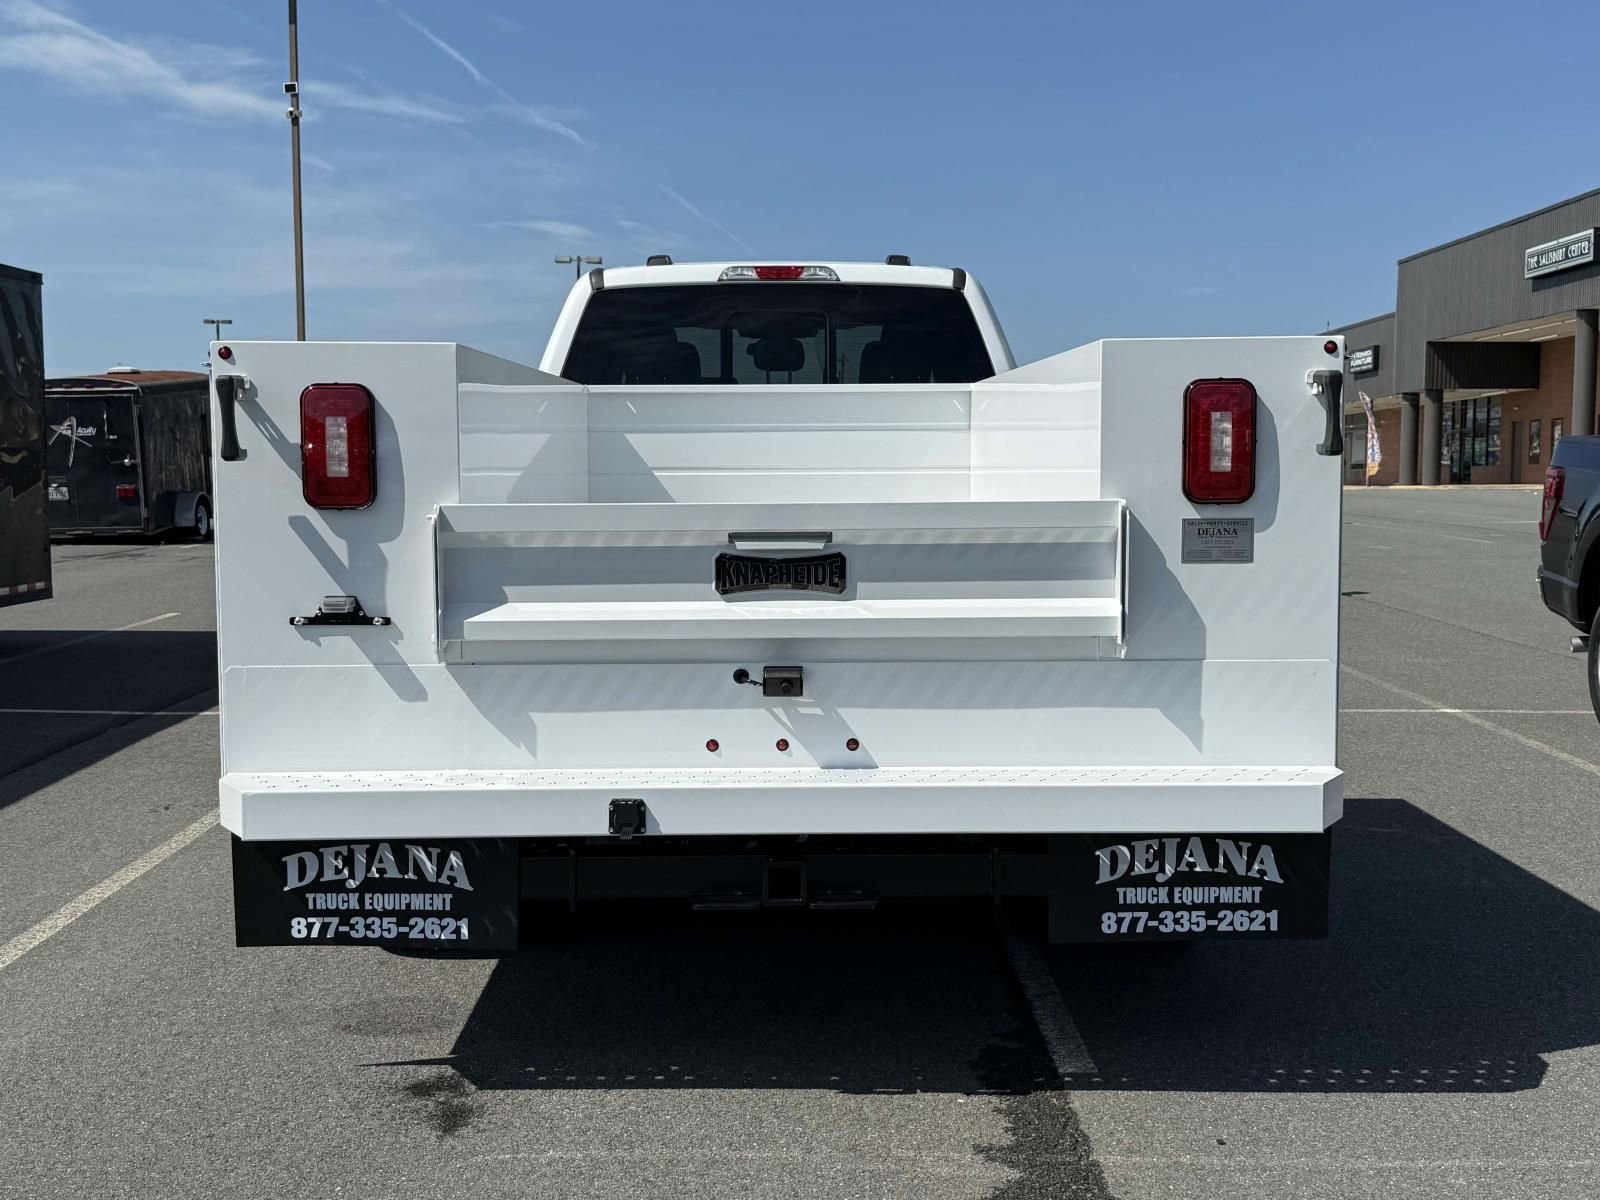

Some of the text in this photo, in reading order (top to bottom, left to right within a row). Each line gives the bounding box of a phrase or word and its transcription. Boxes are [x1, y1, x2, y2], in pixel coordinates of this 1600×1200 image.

[1527, 256, 1538, 270] THE
[1567, 240, 1589, 258] CENTER
[1197, 527, 1239, 538] DEJANA
[719, 557, 842, 590] KNAPHEIDE
[281, 842, 474, 892] DEJANA
[1094, 836, 1284, 885] DEJANA
[305, 892, 453, 911] TRUCK EQUIPMENT
[1116, 886, 1262, 905] TRUCK EQUIPMENT
[290, 916, 469, 940] 877-335-2621
[1101, 909, 1278, 934] 877-335-2621
